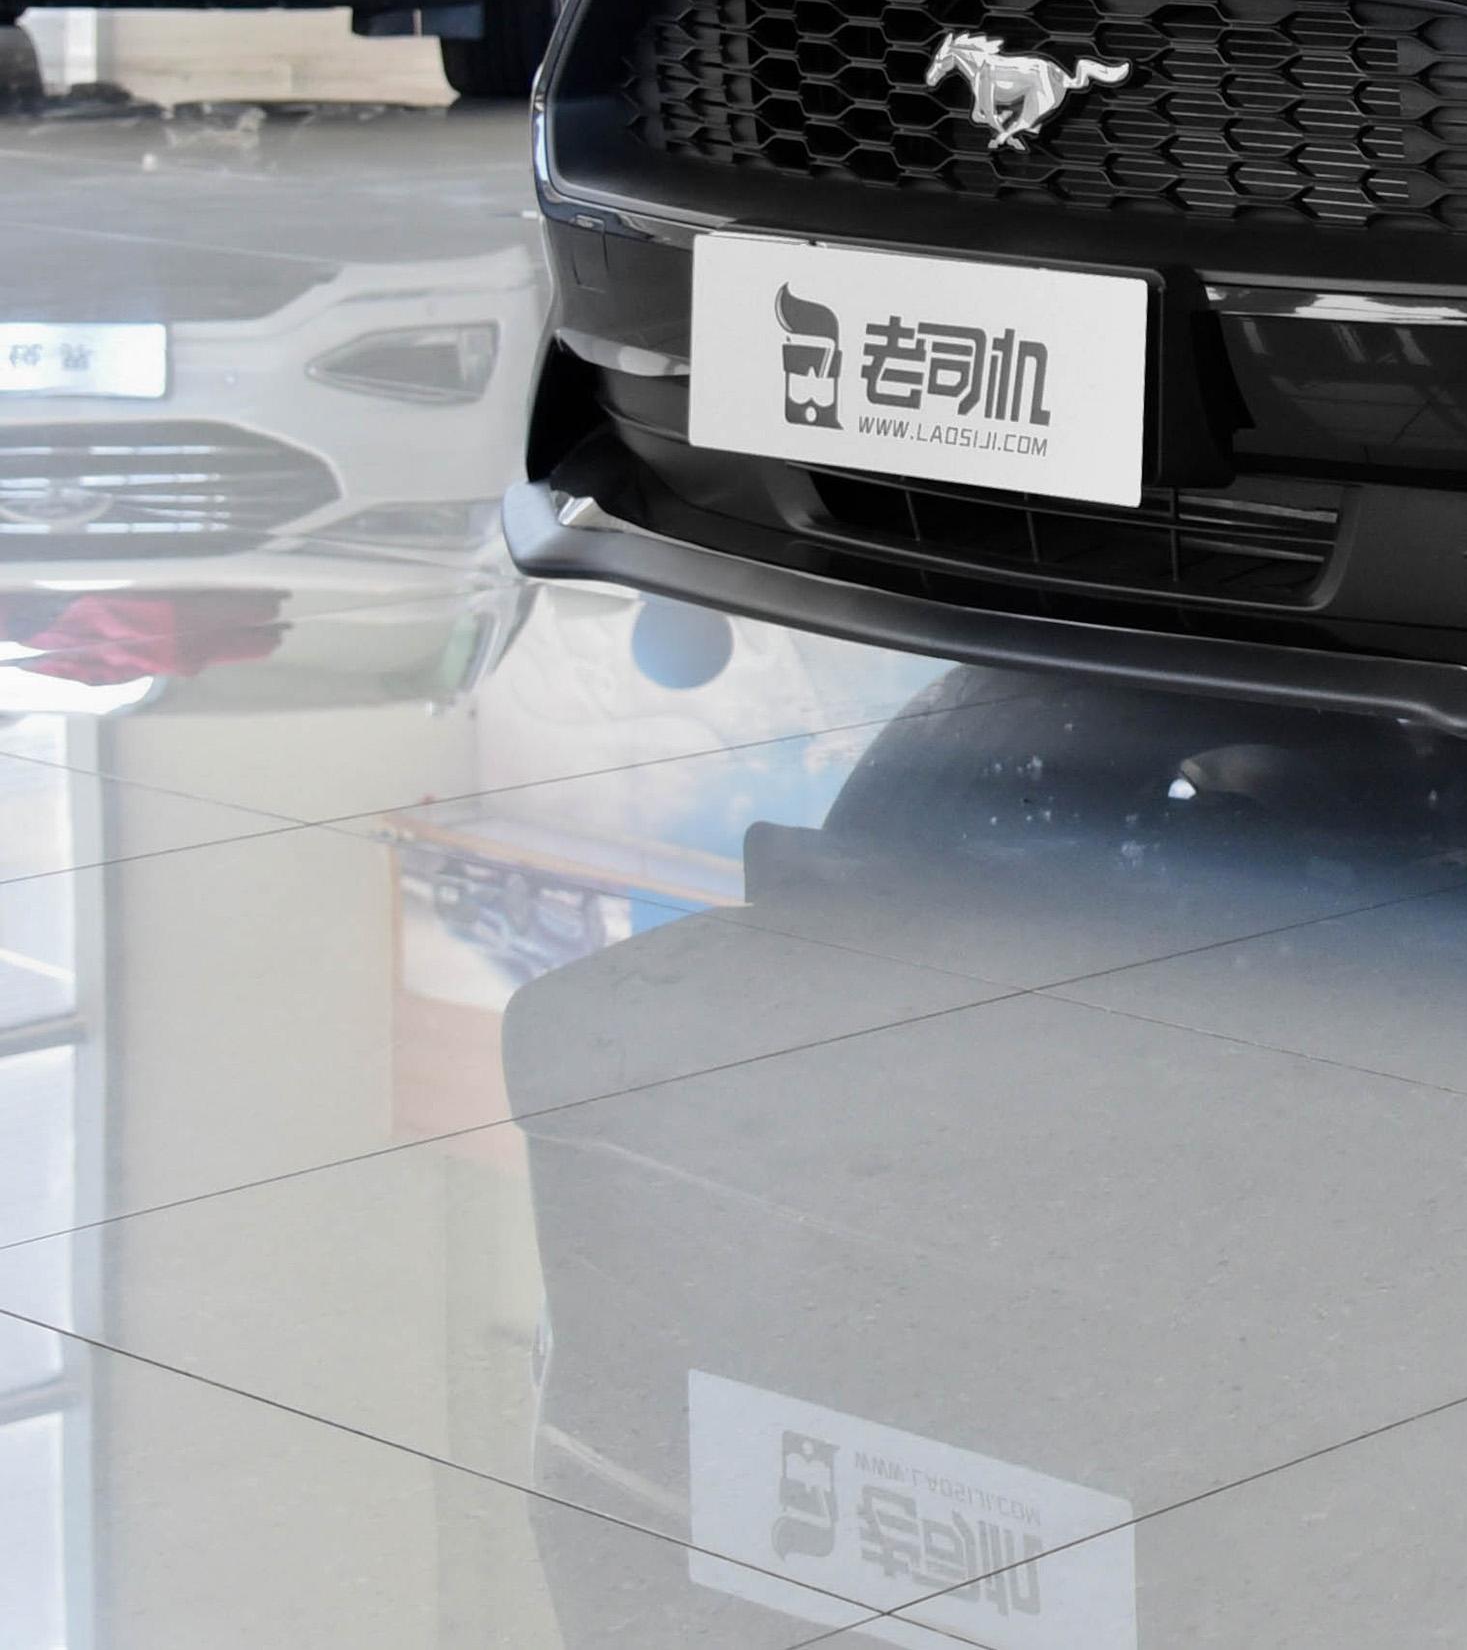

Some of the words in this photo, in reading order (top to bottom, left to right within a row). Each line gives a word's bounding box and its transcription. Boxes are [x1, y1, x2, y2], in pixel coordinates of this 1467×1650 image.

[860, 315, 1051, 426] 老司机
[857, 415, 1049, 458] WWW.LAOSIJI.COM
